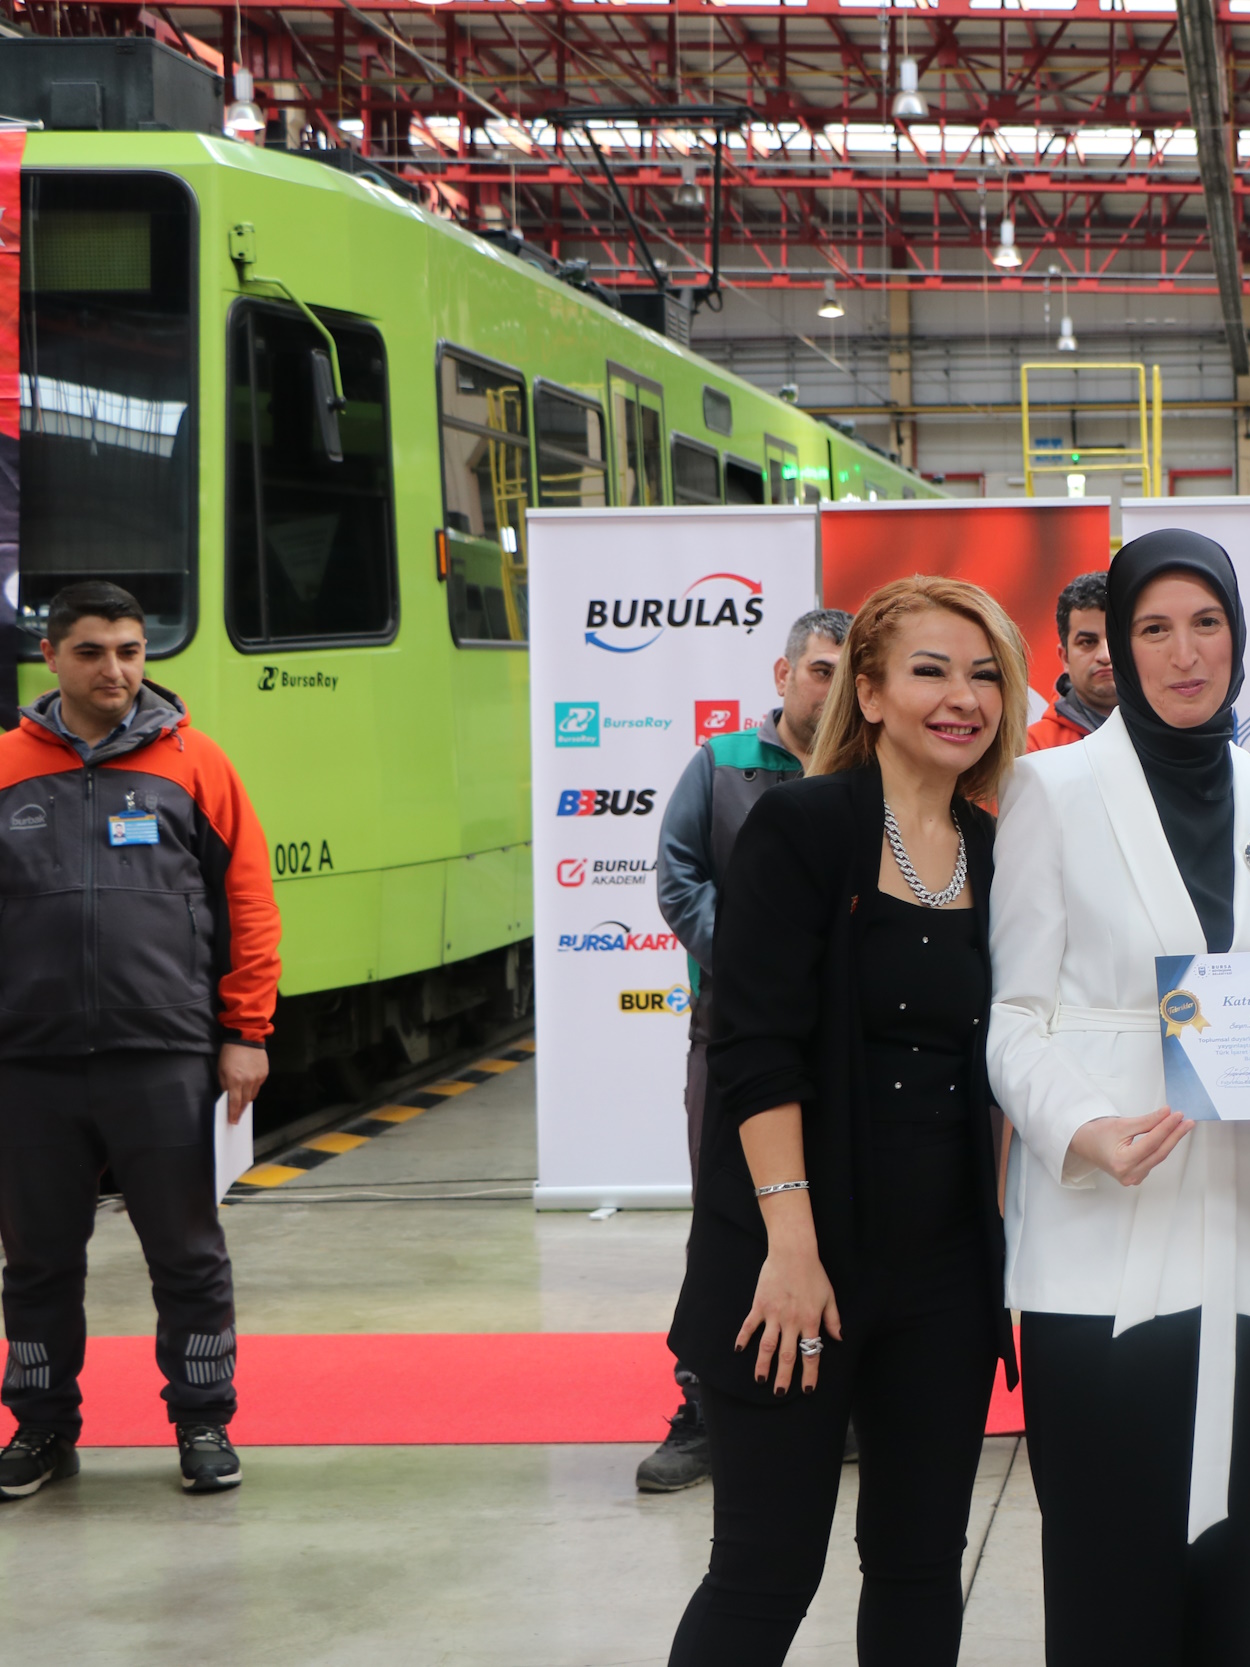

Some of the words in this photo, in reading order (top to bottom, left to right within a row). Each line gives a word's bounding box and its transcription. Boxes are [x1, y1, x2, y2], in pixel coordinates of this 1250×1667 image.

[586, 598, 764, 634] BURULAŞ
[282, 671, 338, 692] BursaRay
[604, 717, 672, 730] BursaRay
[558, 736, 597, 744] BursaRay
[557, 789, 657, 816] BBBUS
[276, 842, 312, 875] 002
[318, 840, 334, 871] A
[593, 860, 658, 872] BURULA
[592, 874, 646, 885] AKADEMİ
[558, 934, 678, 952] BURSAKART
